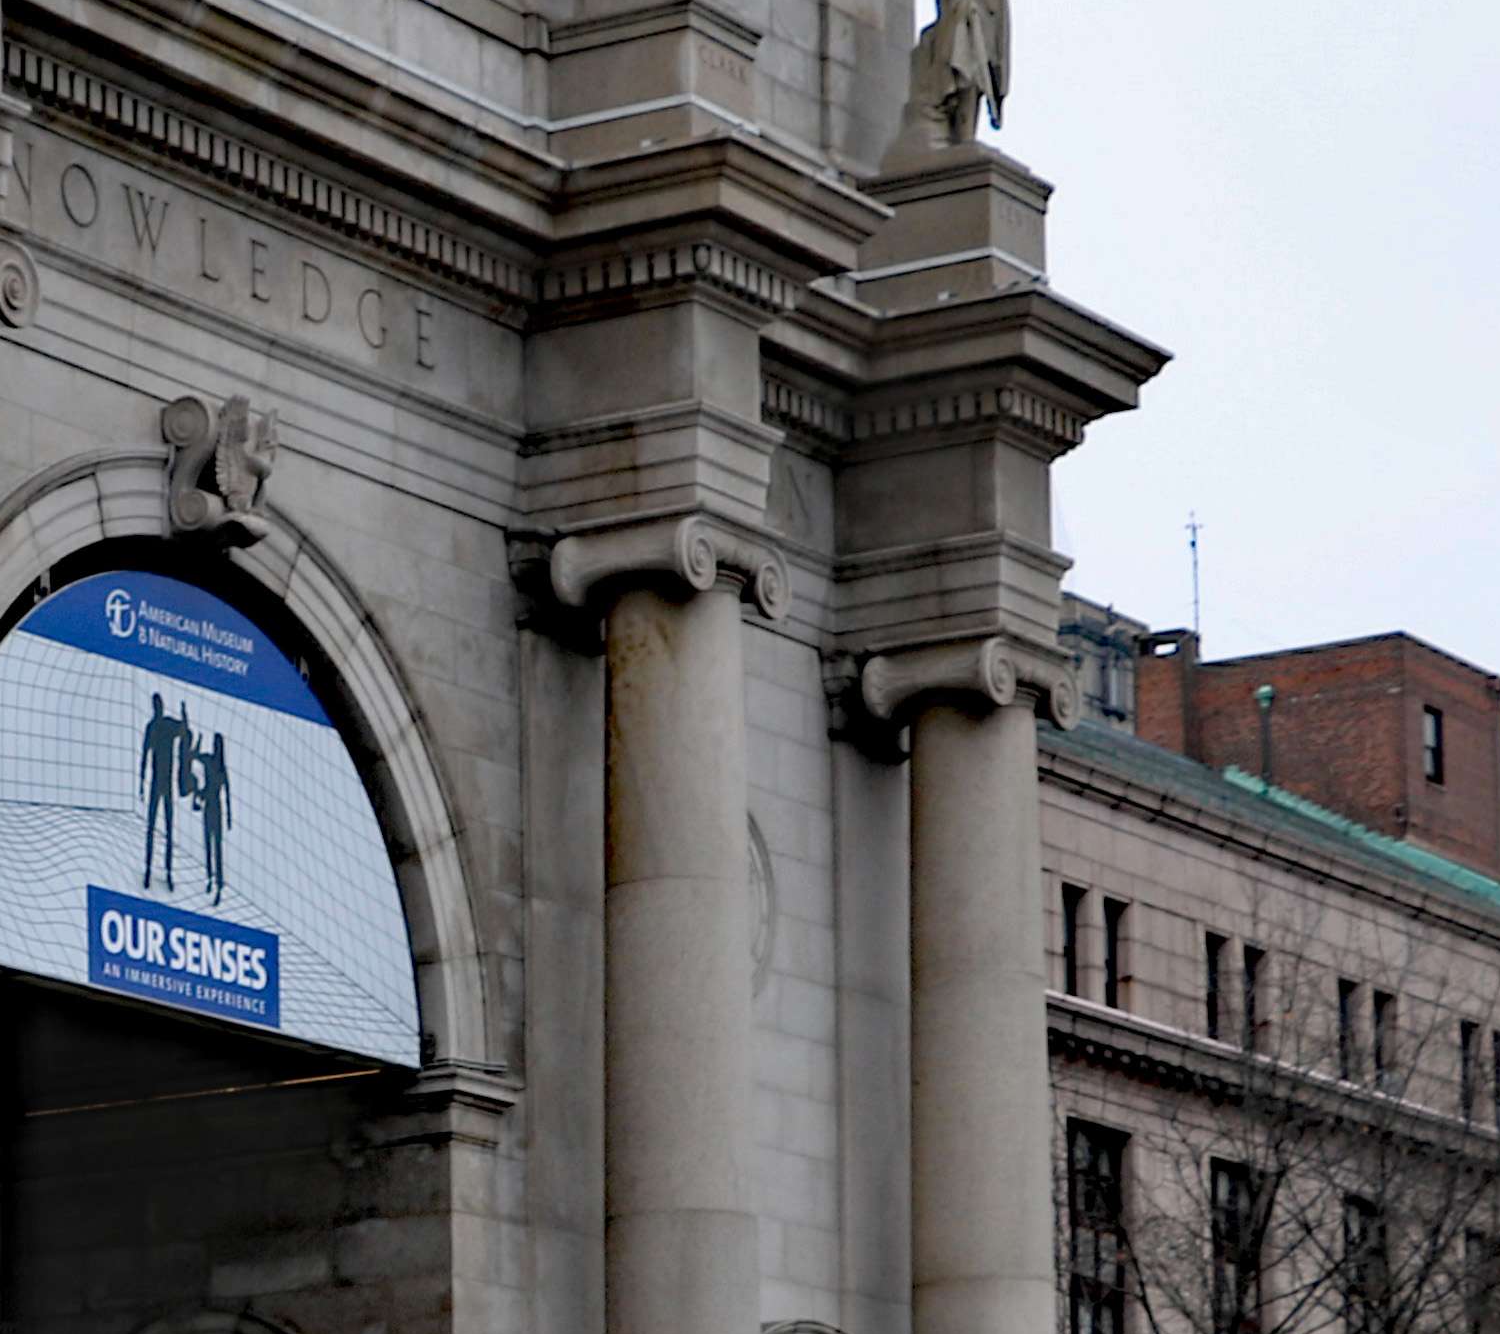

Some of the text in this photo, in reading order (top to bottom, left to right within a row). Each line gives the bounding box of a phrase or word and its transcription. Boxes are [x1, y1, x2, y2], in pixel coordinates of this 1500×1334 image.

[12, 142, 437, 373] NOWLEDGE
[149, 626, 201, 664] NATURAL
[202, 644, 250, 676] HISTORY
[101, 909, 268, 991] OUR SENSES
[103, 962, 267, 1016] AN IMMERSIVE EXPERIENCE
